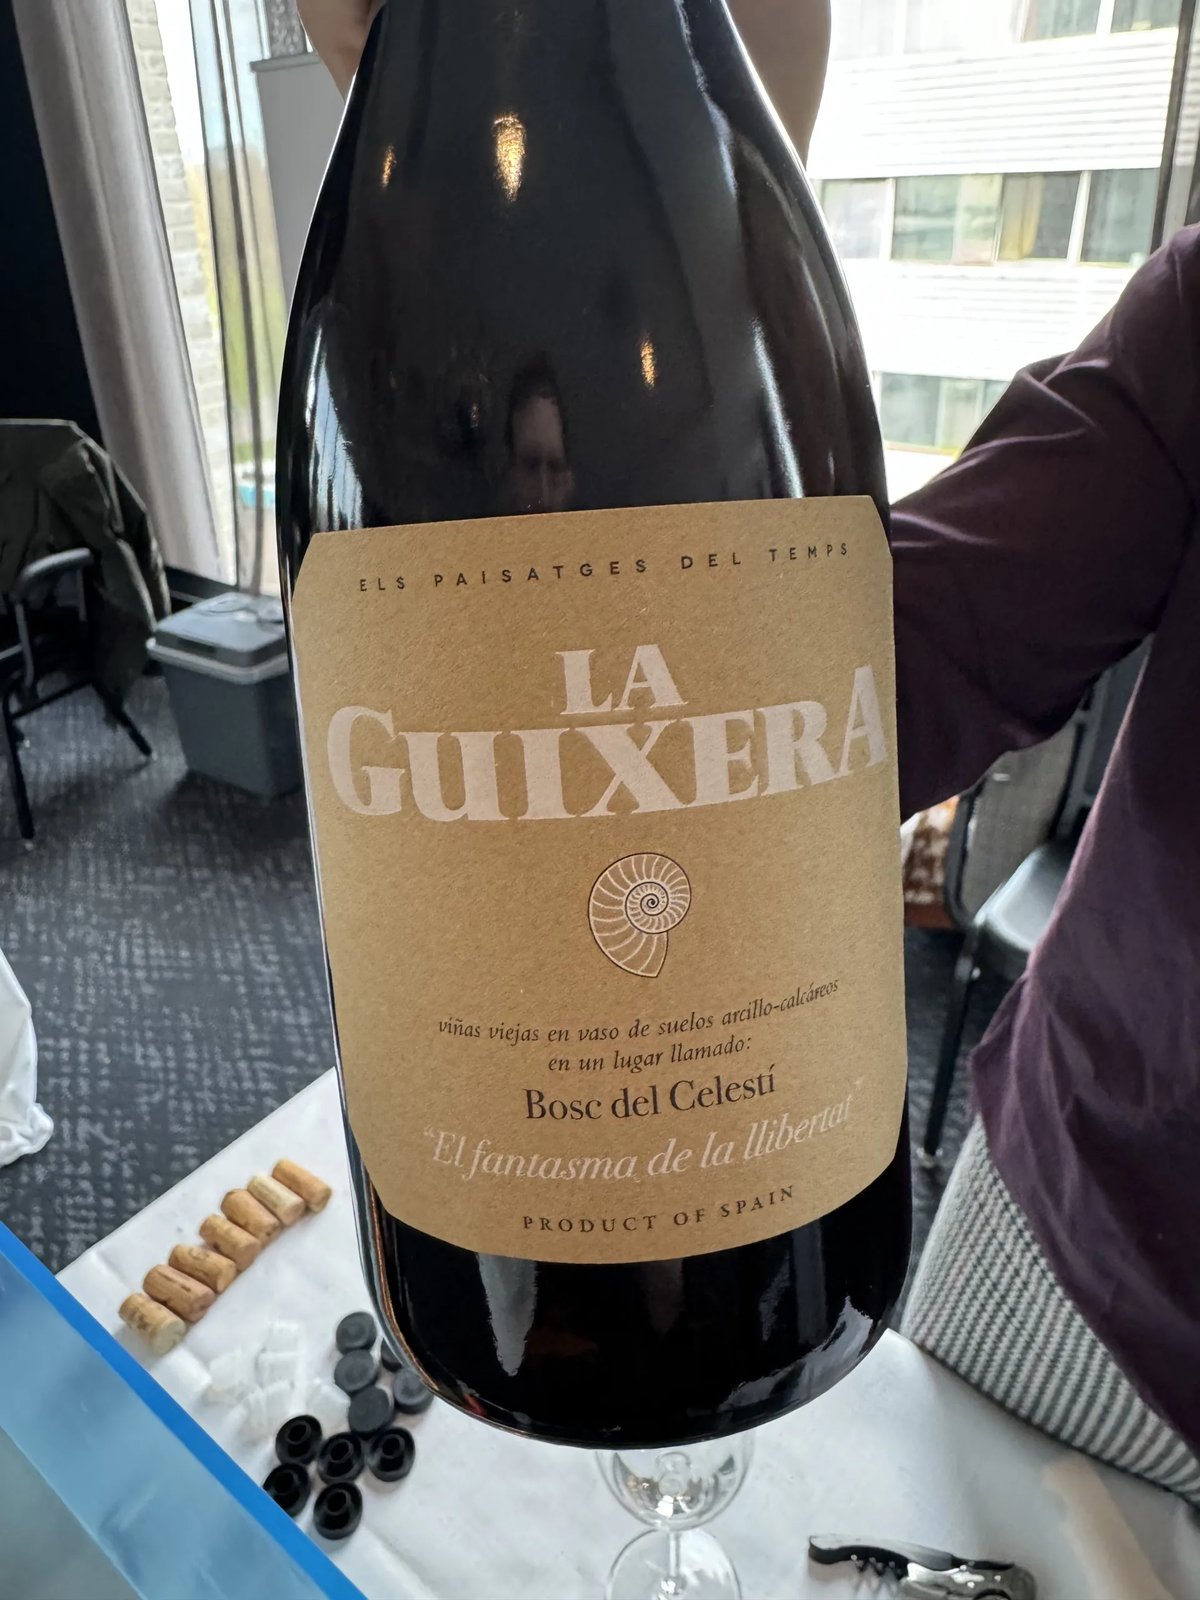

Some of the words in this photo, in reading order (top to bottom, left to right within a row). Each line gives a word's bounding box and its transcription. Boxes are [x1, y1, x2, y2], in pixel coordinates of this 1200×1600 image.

[359, 575, 406, 592] ELS
[434, 557, 647, 588] PAISATGES
[680, 551, 742, 571] DEL
[768, 541, 850, 563] TEMPS
[555, 643, 689, 715] LA
[327, 664, 888, 822] GUIXERA
[438, 1017, 481, 1039] viñas
[488, 1022, 540, 1047] viejas
[547, 1027, 570, 1043] en
[577, 1027, 620, 1042] vaso
[627, 1018, 651, 1039] de
[657, 1012, 715, 1036] suelos
[721, 976, 840, 1027] arcillo-calcáreos
[547, 1055, 571, 1072] en
[579, 1055, 605, 1071] un
[612, 1050, 664, 1075] lugar
[669, 1036, 753, 1062] llamado:
[523, 1087, 602, 1121] Bosc
[610, 1080, 660, 1119] del
[668, 1063, 777, 1113] Celestí
[462, 1139, 637, 1182] fantasma
[646, 1137, 694, 1177] de
[700, 1131, 738, 1169] la
[522, 1214, 657, 1233] PRODUCT
[672, 1208, 706, 1227] OF
[720, 1184, 794, 1218] SPAIN
